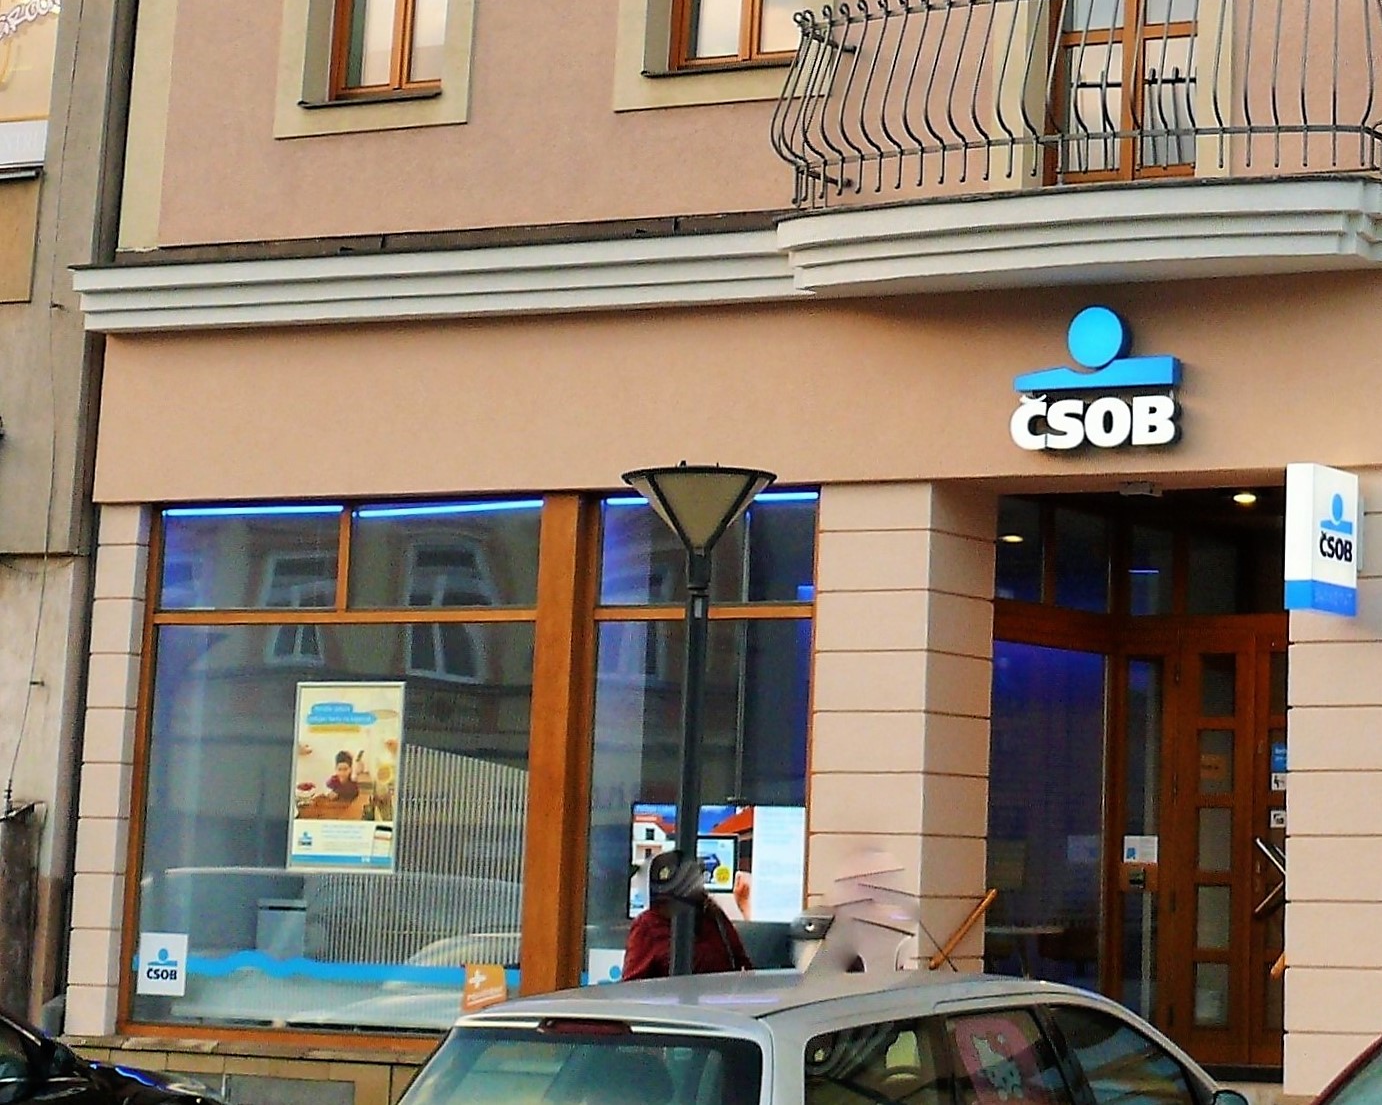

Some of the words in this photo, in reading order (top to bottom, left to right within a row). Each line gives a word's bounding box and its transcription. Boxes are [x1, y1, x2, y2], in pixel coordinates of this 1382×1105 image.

[1010, 394, 1175, 450] ČSOB
[1320, 531, 1352, 562] ČSOB
[146, 968, 177, 980] ČSOB
